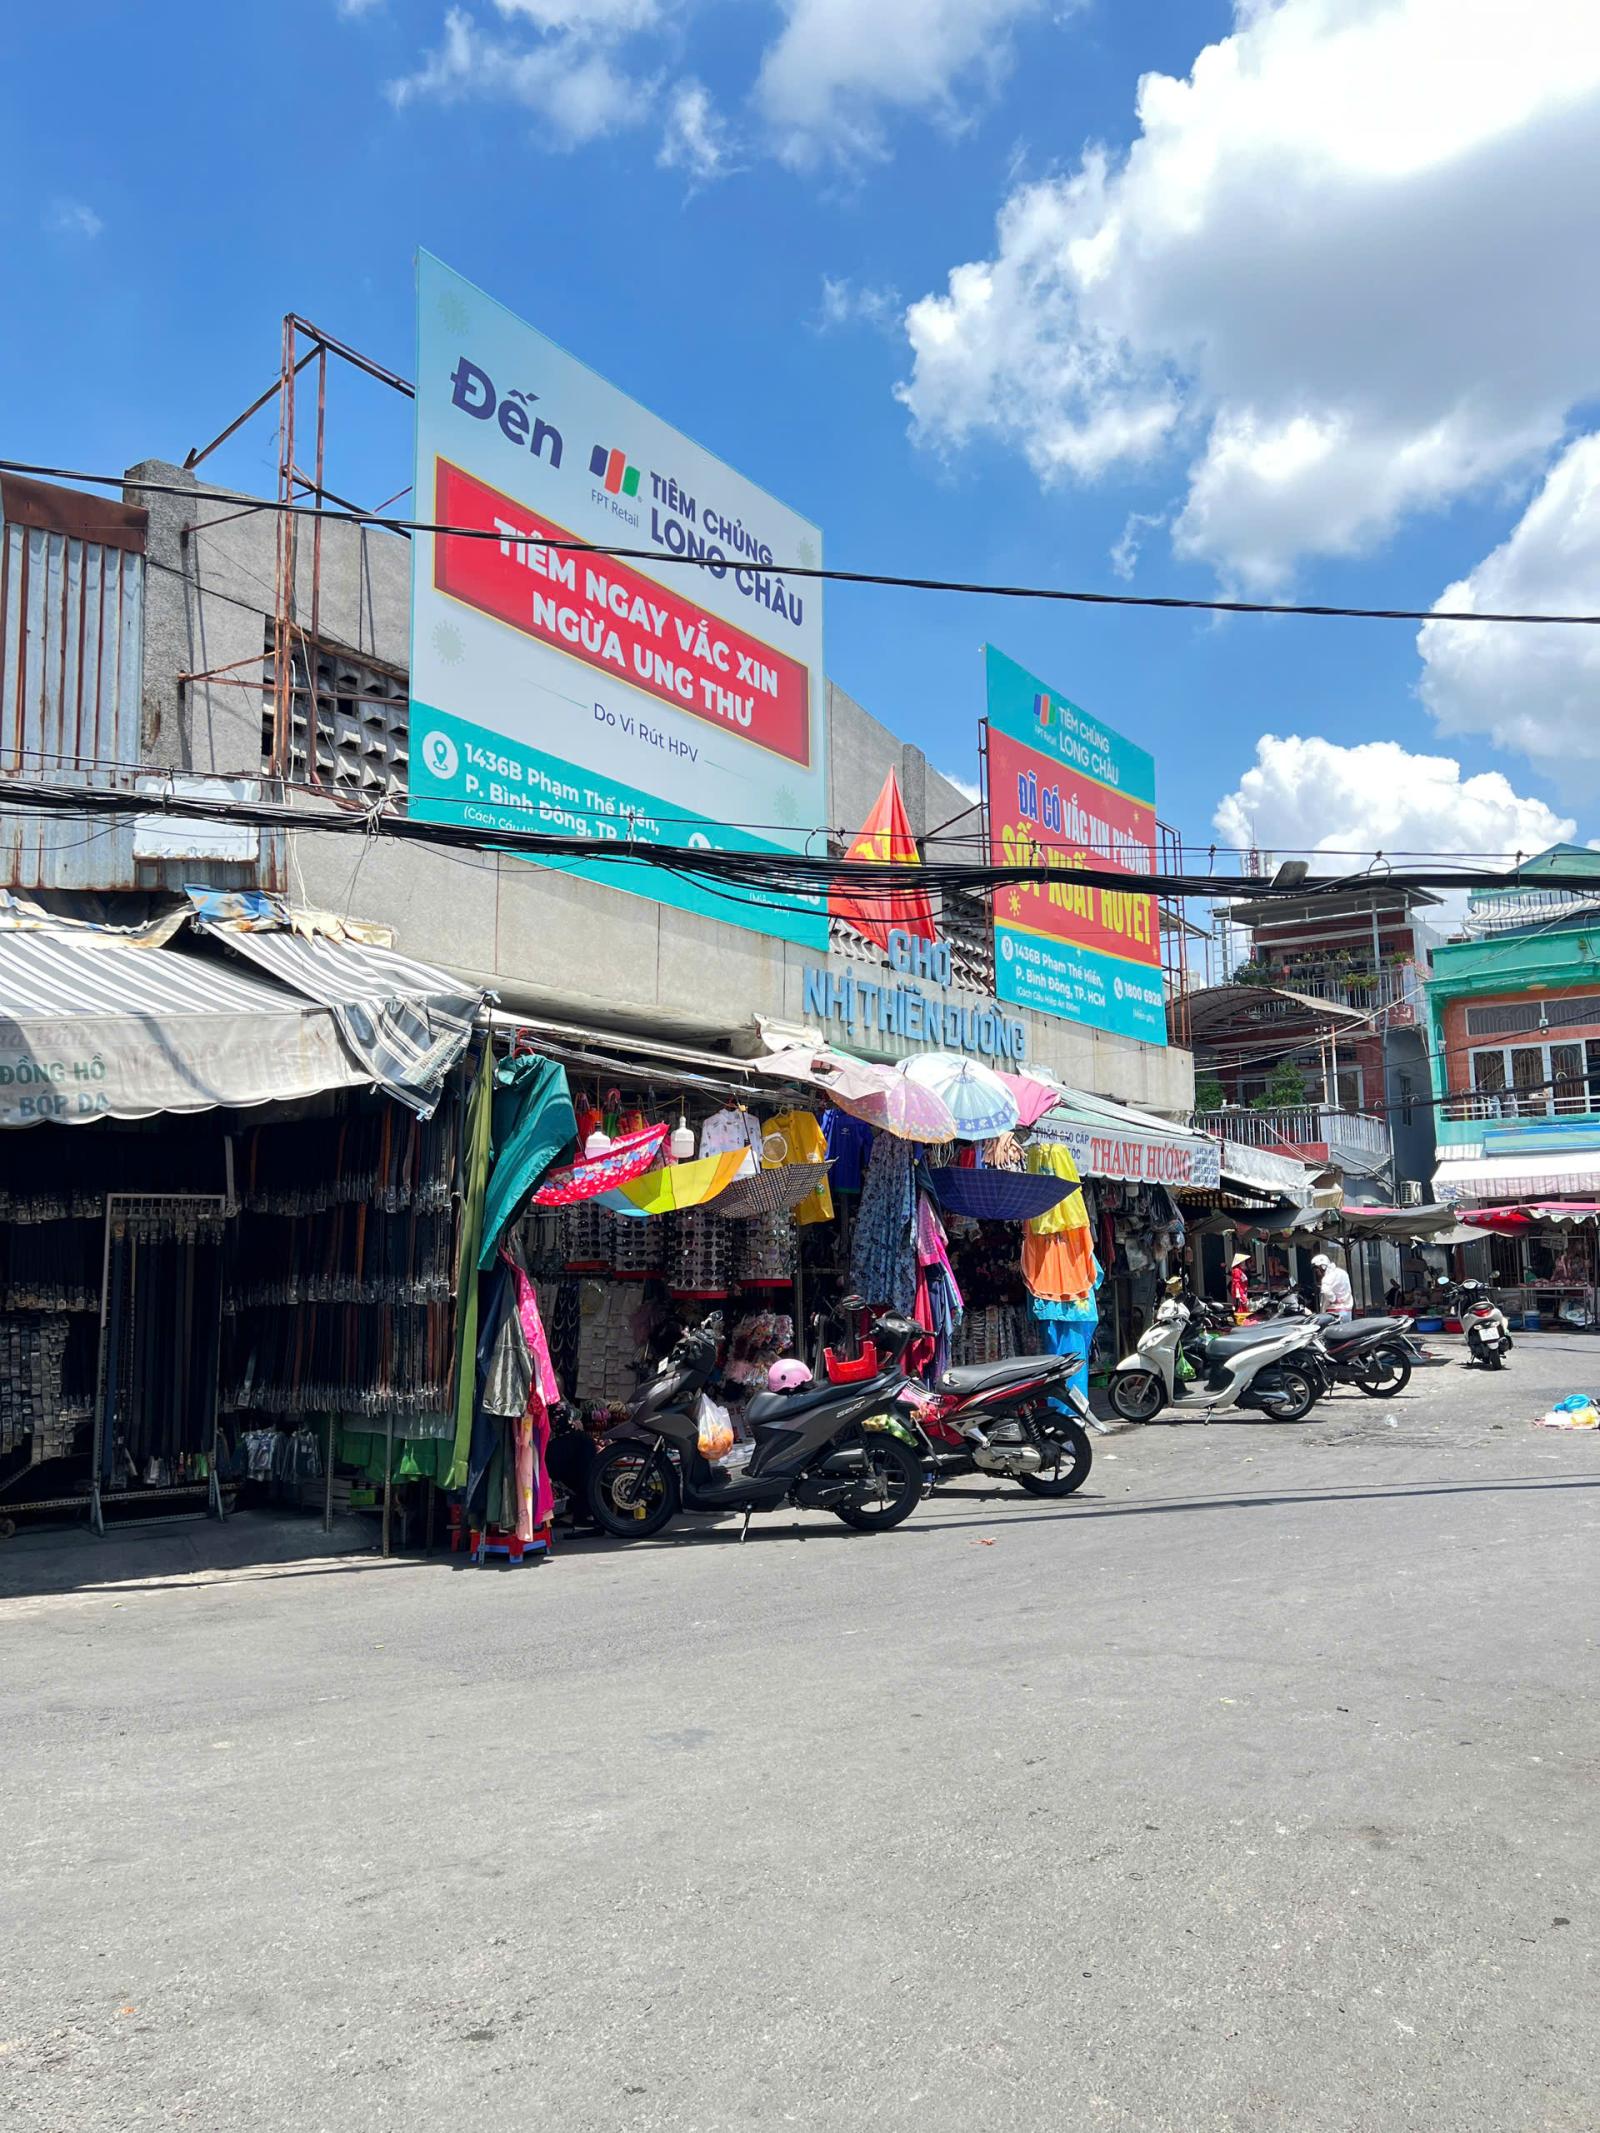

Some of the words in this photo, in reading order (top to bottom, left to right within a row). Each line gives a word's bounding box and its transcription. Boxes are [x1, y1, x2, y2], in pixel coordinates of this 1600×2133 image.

[450, 356, 564, 469] Đến
[591, 489, 610, 510] FPT
[611, 502, 639, 528] Retail
[650, 471, 696, 523] TIÊM
[702, 508, 773, 567] CHỦNG
[651, 507, 727, 580] LONG
[734, 562, 803, 627] CHÂU
[494, 516, 576, 592] TIÊM
[585, 568, 669, 638] NGAY
[674, 619, 730, 672] VẮC
[736, 651, 778, 698] XIN
[532, 591, 626, 668] NGỪA
[633, 643, 694, 700] UNG
[700, 677, 754, 728] THƯ
[594, 702, 616, 727] Do
[619, 716, 634, 737] Vi
[639, 721, 665, 749] Rút
[668, 734, 699, 763] HPV
[1059, 706, 1079, 735] TIÊM
[1079, 722, 1110, 754] CHỦNG
[464, 743, 523, 782] 1436B
[527, 766, 580, 803] Phạm
[583, 788, 616, 816] Thế
[1060, 731, 1090, 767] LONG
[1090, 753, 1120, 786] CHÂU
[464, 805, 497, 827] (Cách
[465, 773, 485, 798] P.
[489, 782, 534, 815] Bình
[1017, 769, 1040, 824] ĐÃ
[1042, 784, 1062, 834] CÓ
[1062, 792, 1088, 847] VẮC
[1089, 814, 1111, 860] XIN
[1112, 826, 1151, 876] PHÒNG
[887, 928, 952, 991] CHỢ
[1014, 942, 1041, 965] 1436B
[1042, 953, 1067, 974] Phạm
[1067, 962, 1083, 980] Thế
[1015, 965, 1025, 980] P.
[1073, 984, 1087, 1001] TP.
[1087, 989, 1106, 1007] HCM
[1124, 981, 1142, 1001] 1800
[1143, 988, 1162, 1008] 6928
[803, 966, 856, 1036] NHỊ
[857, 979, 942, 1044] THIÊN
[942, 1001, 1025, 1061] ĐƯỜNG
[0, 1055, 65, 1086] ĐỒNG
[74, 1053, 105, 1081] HỒ
[20, 1091, 69, 1117] BÓP
[78, 1091, 110, 1113] DA
[1075, 1130, 1090, 1145] CẤP
[1090, 1137, 1143, 1176] THANH
[1146, 1141, 1193, 1181] HƯƠNG
